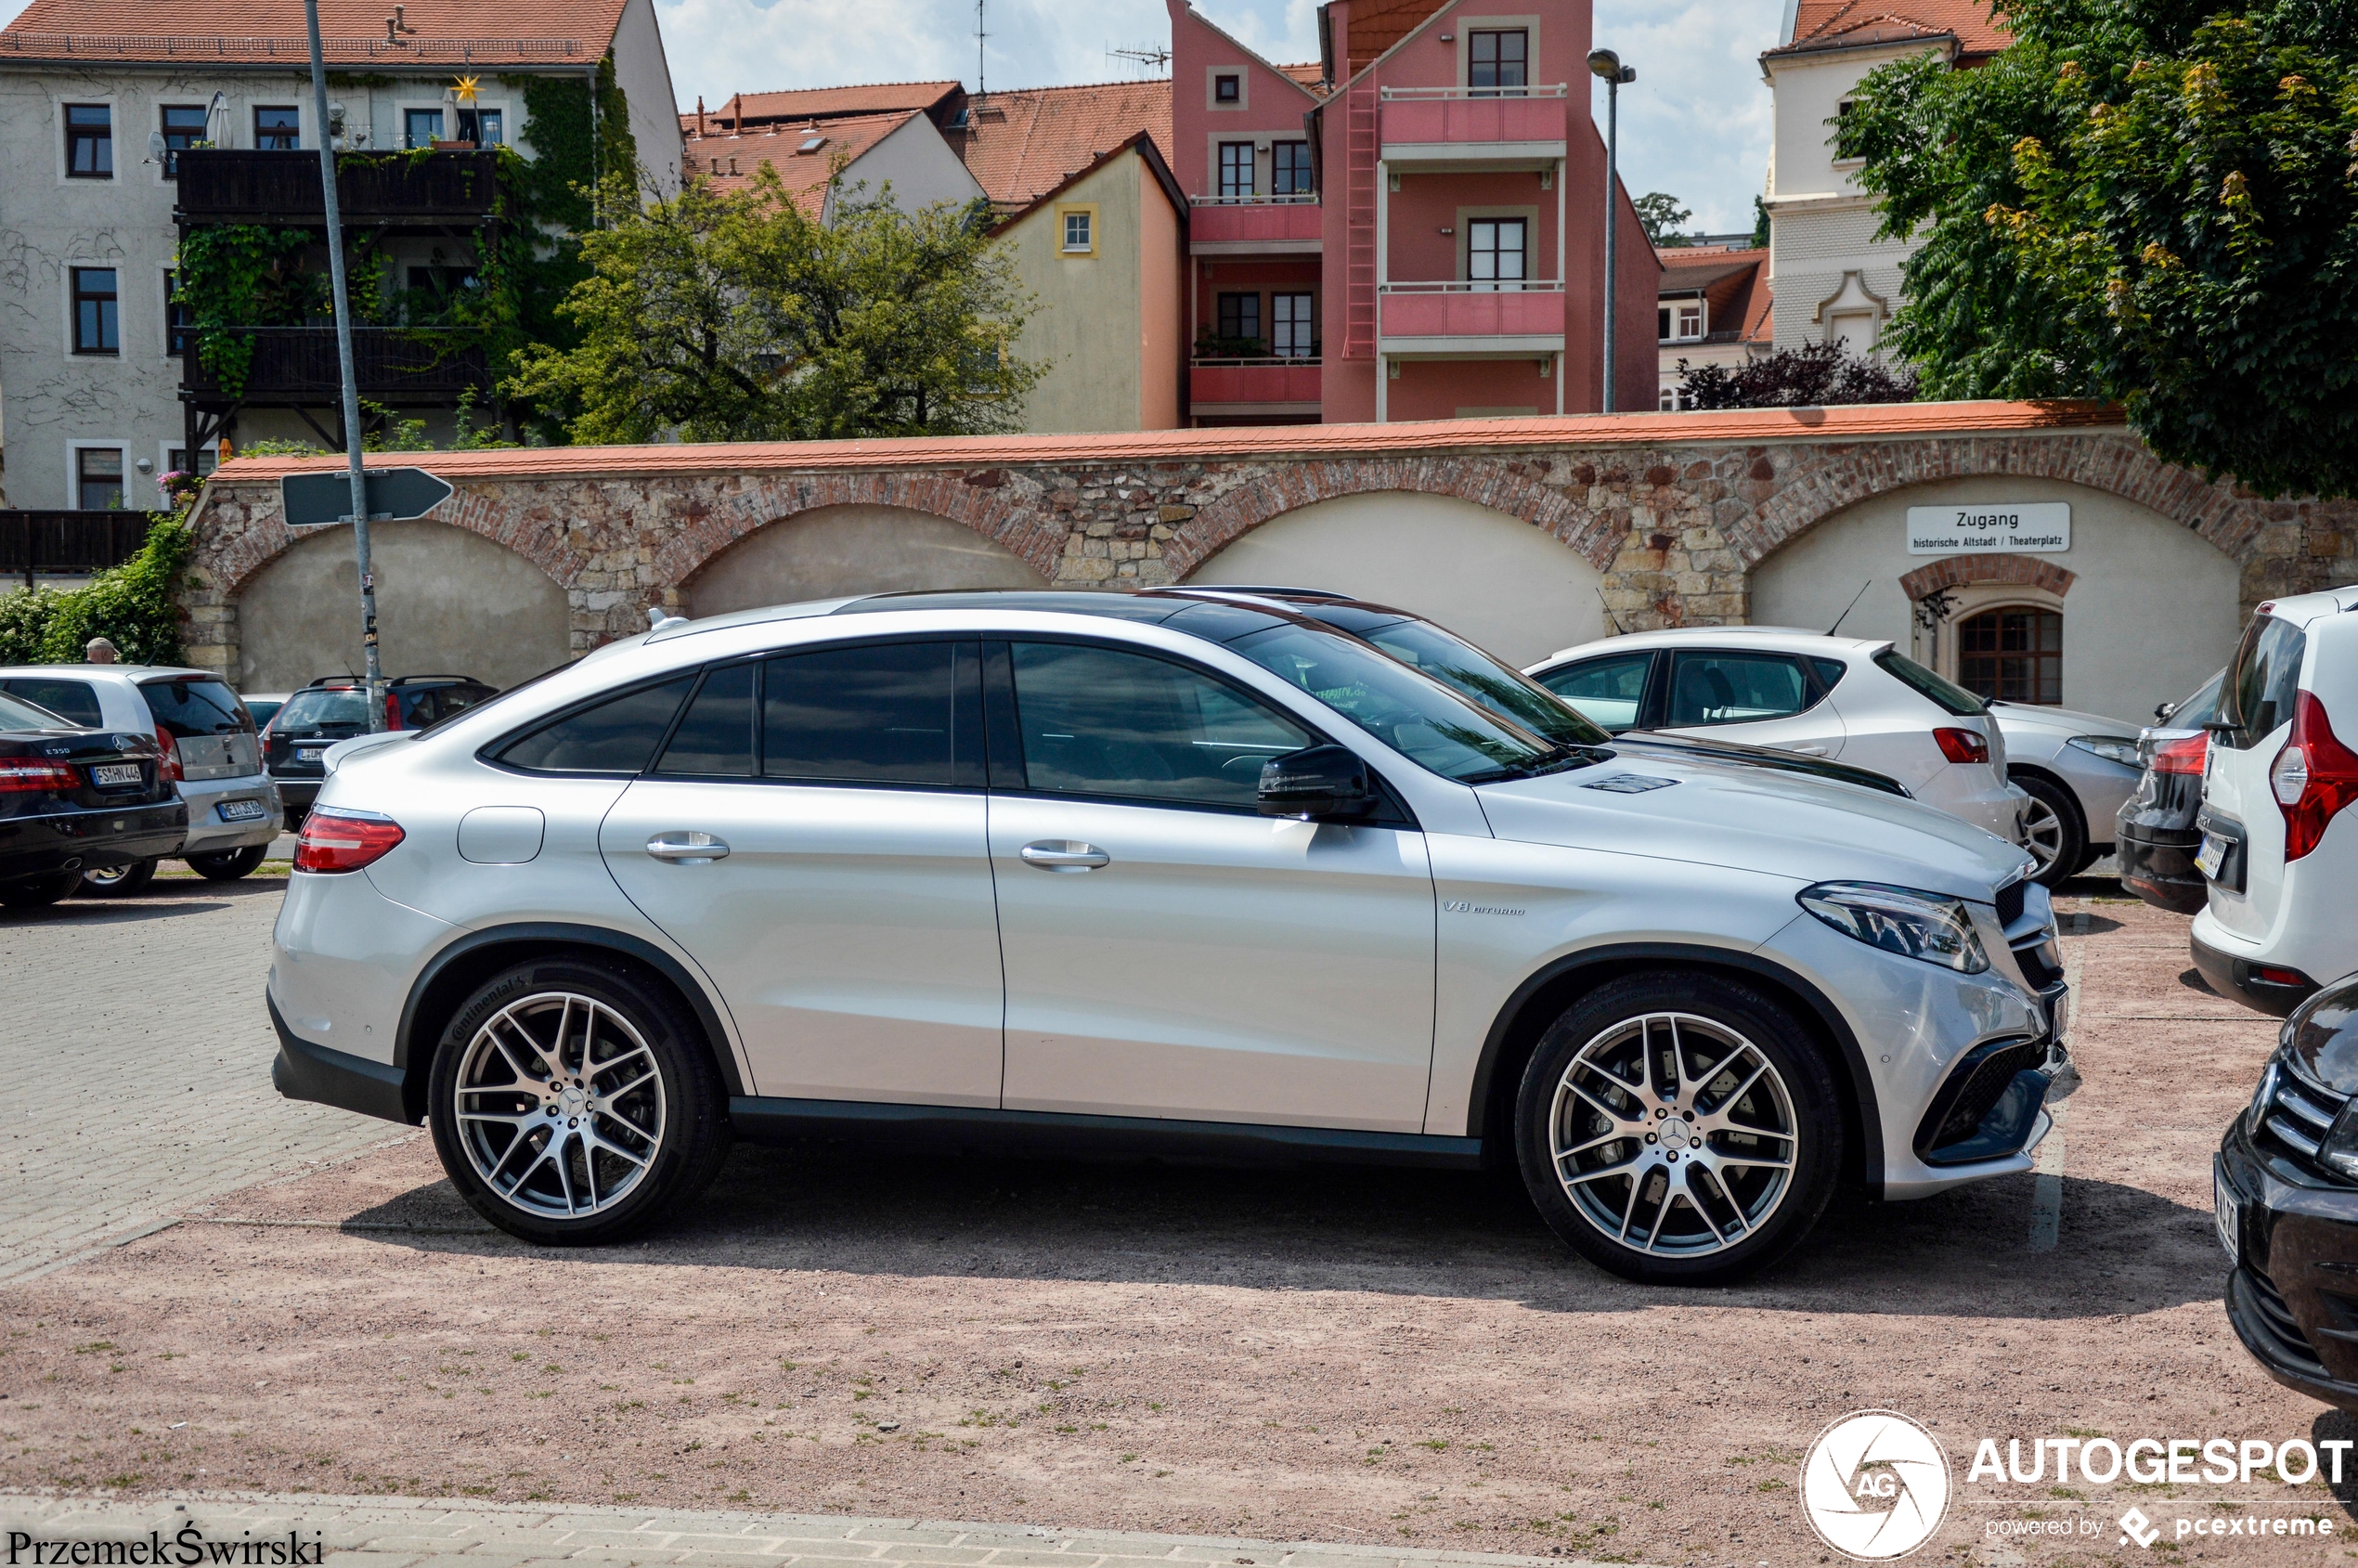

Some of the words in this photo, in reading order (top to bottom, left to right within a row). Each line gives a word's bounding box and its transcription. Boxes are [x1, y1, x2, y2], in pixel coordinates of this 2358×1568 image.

[1956, 512, 2019, 529] Zugang
[1913, 537, 1959, 548] historische
[1963, 536, 1996, 547] Altstadt
[2009, 535, 2062, 547] Theaterplatz
[97, 769, 110, 783] FS
[113, 768, 126, 782] HN
[126, 766, 139, 781] 446
[1443, 900, 1471, 913] V8
[1472, 905, 1525, 916] BITURBO
[451, 978, 514, 1042] Continental
